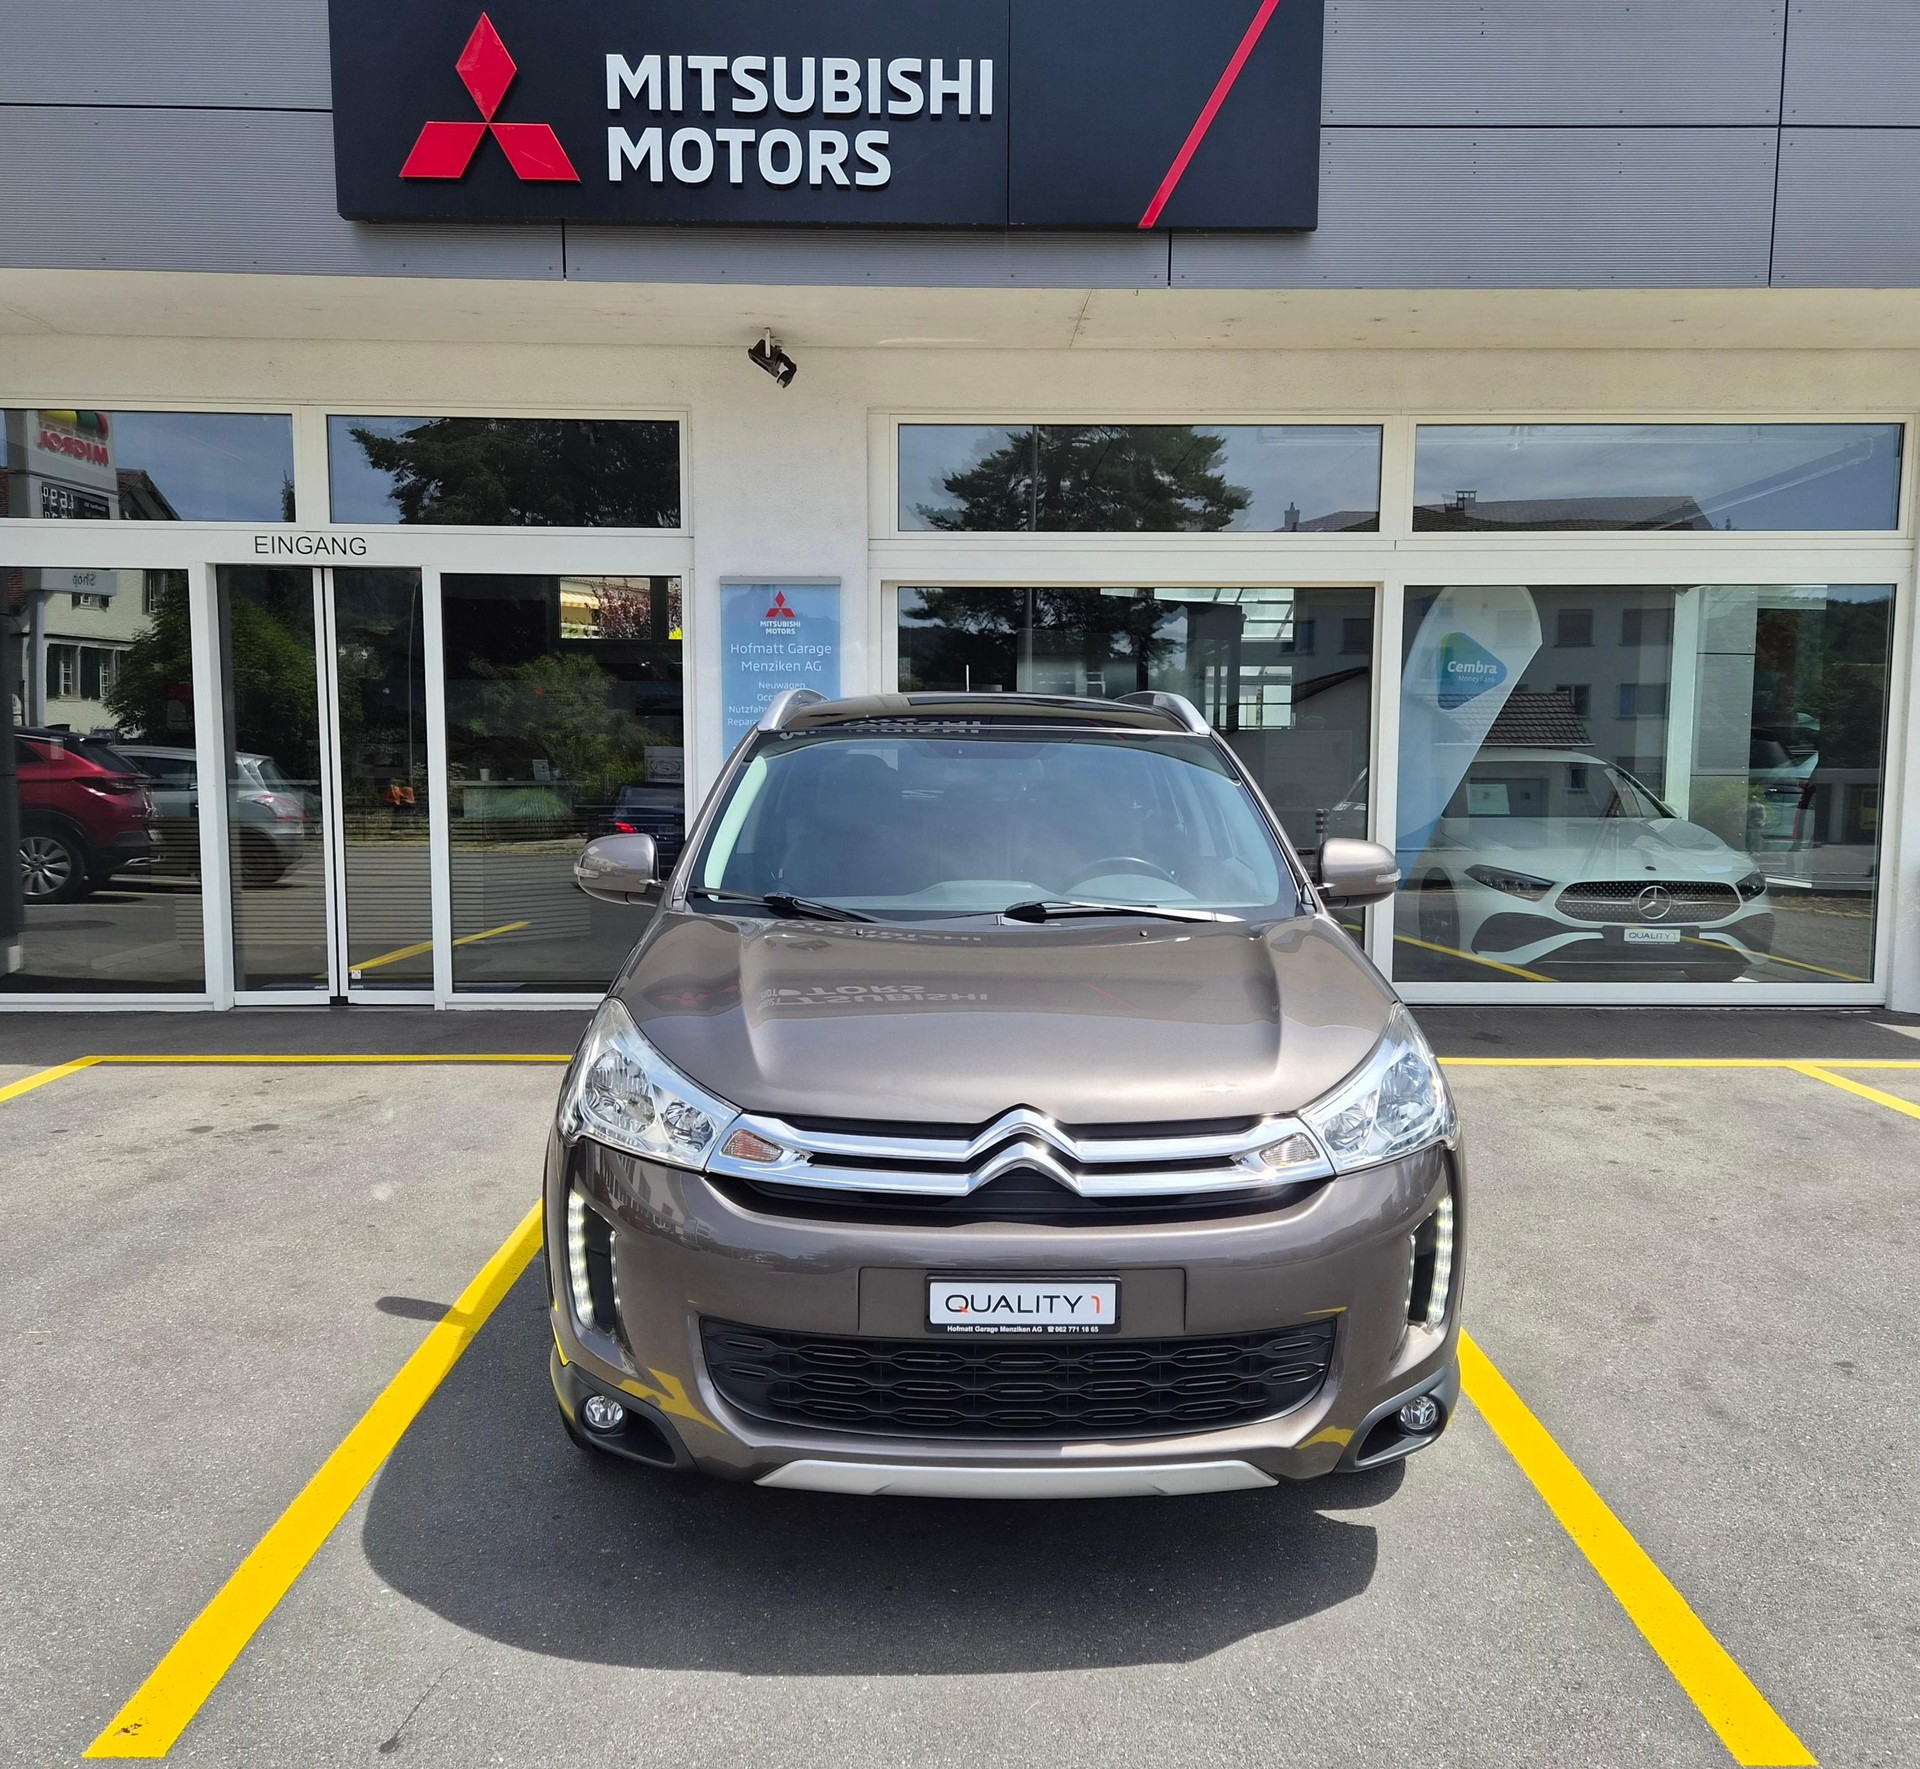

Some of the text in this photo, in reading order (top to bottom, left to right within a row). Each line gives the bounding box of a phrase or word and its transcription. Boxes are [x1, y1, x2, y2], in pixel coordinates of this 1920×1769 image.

[605, 53, 993, 116] MITSUBISHI
[607, 126, 892, 186] MOTORS
[254, 535, 367, 556] EINGANG
[760, 620, 801, 628] MITSUBISHI
[730, 643, 832, 657] Hofmatt Garage
[741, 661, 822, 672] Menziken AG
[1447, 660, 1497, 674] Cembra
[757, 693, 777, 702] Occ
[1628, 932, 1671, 940] QUALITY
[945, 1294, 1101, 1314] QUALITY 1
[974, 1326, 999, 1334] Garage
